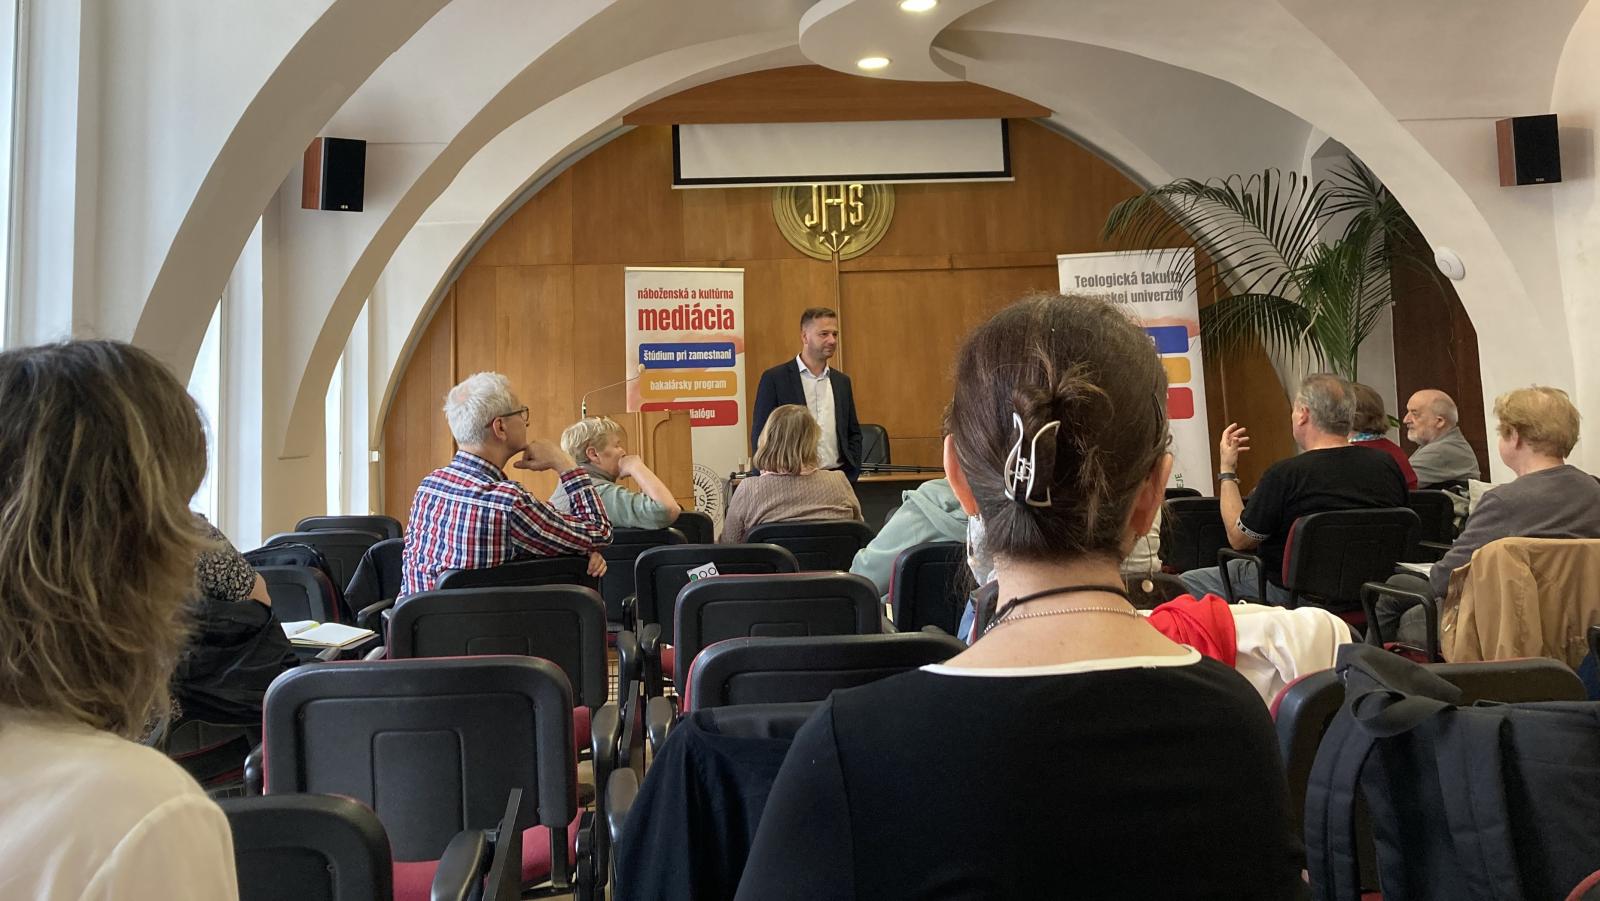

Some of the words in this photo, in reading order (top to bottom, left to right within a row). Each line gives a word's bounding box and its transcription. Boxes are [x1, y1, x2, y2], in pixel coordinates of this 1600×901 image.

[1074, 271, 1138, 288] Teologická
[1141, 270, 1183, 285] fakulta
[637, 288, 689, 299] náboženská
[691, 291, 697, 299] a
[698, 288, 734, 299] kultúrna
[1131, 288, 1184, 302] univerzity
[638, 303, 735, 331] mediácia
[643, 349, 675, 361] štúdium
[676, 350, 687, 362] pri
[650, 379, 693, 391] bakalársky
[694, 380, 727, 391] program
